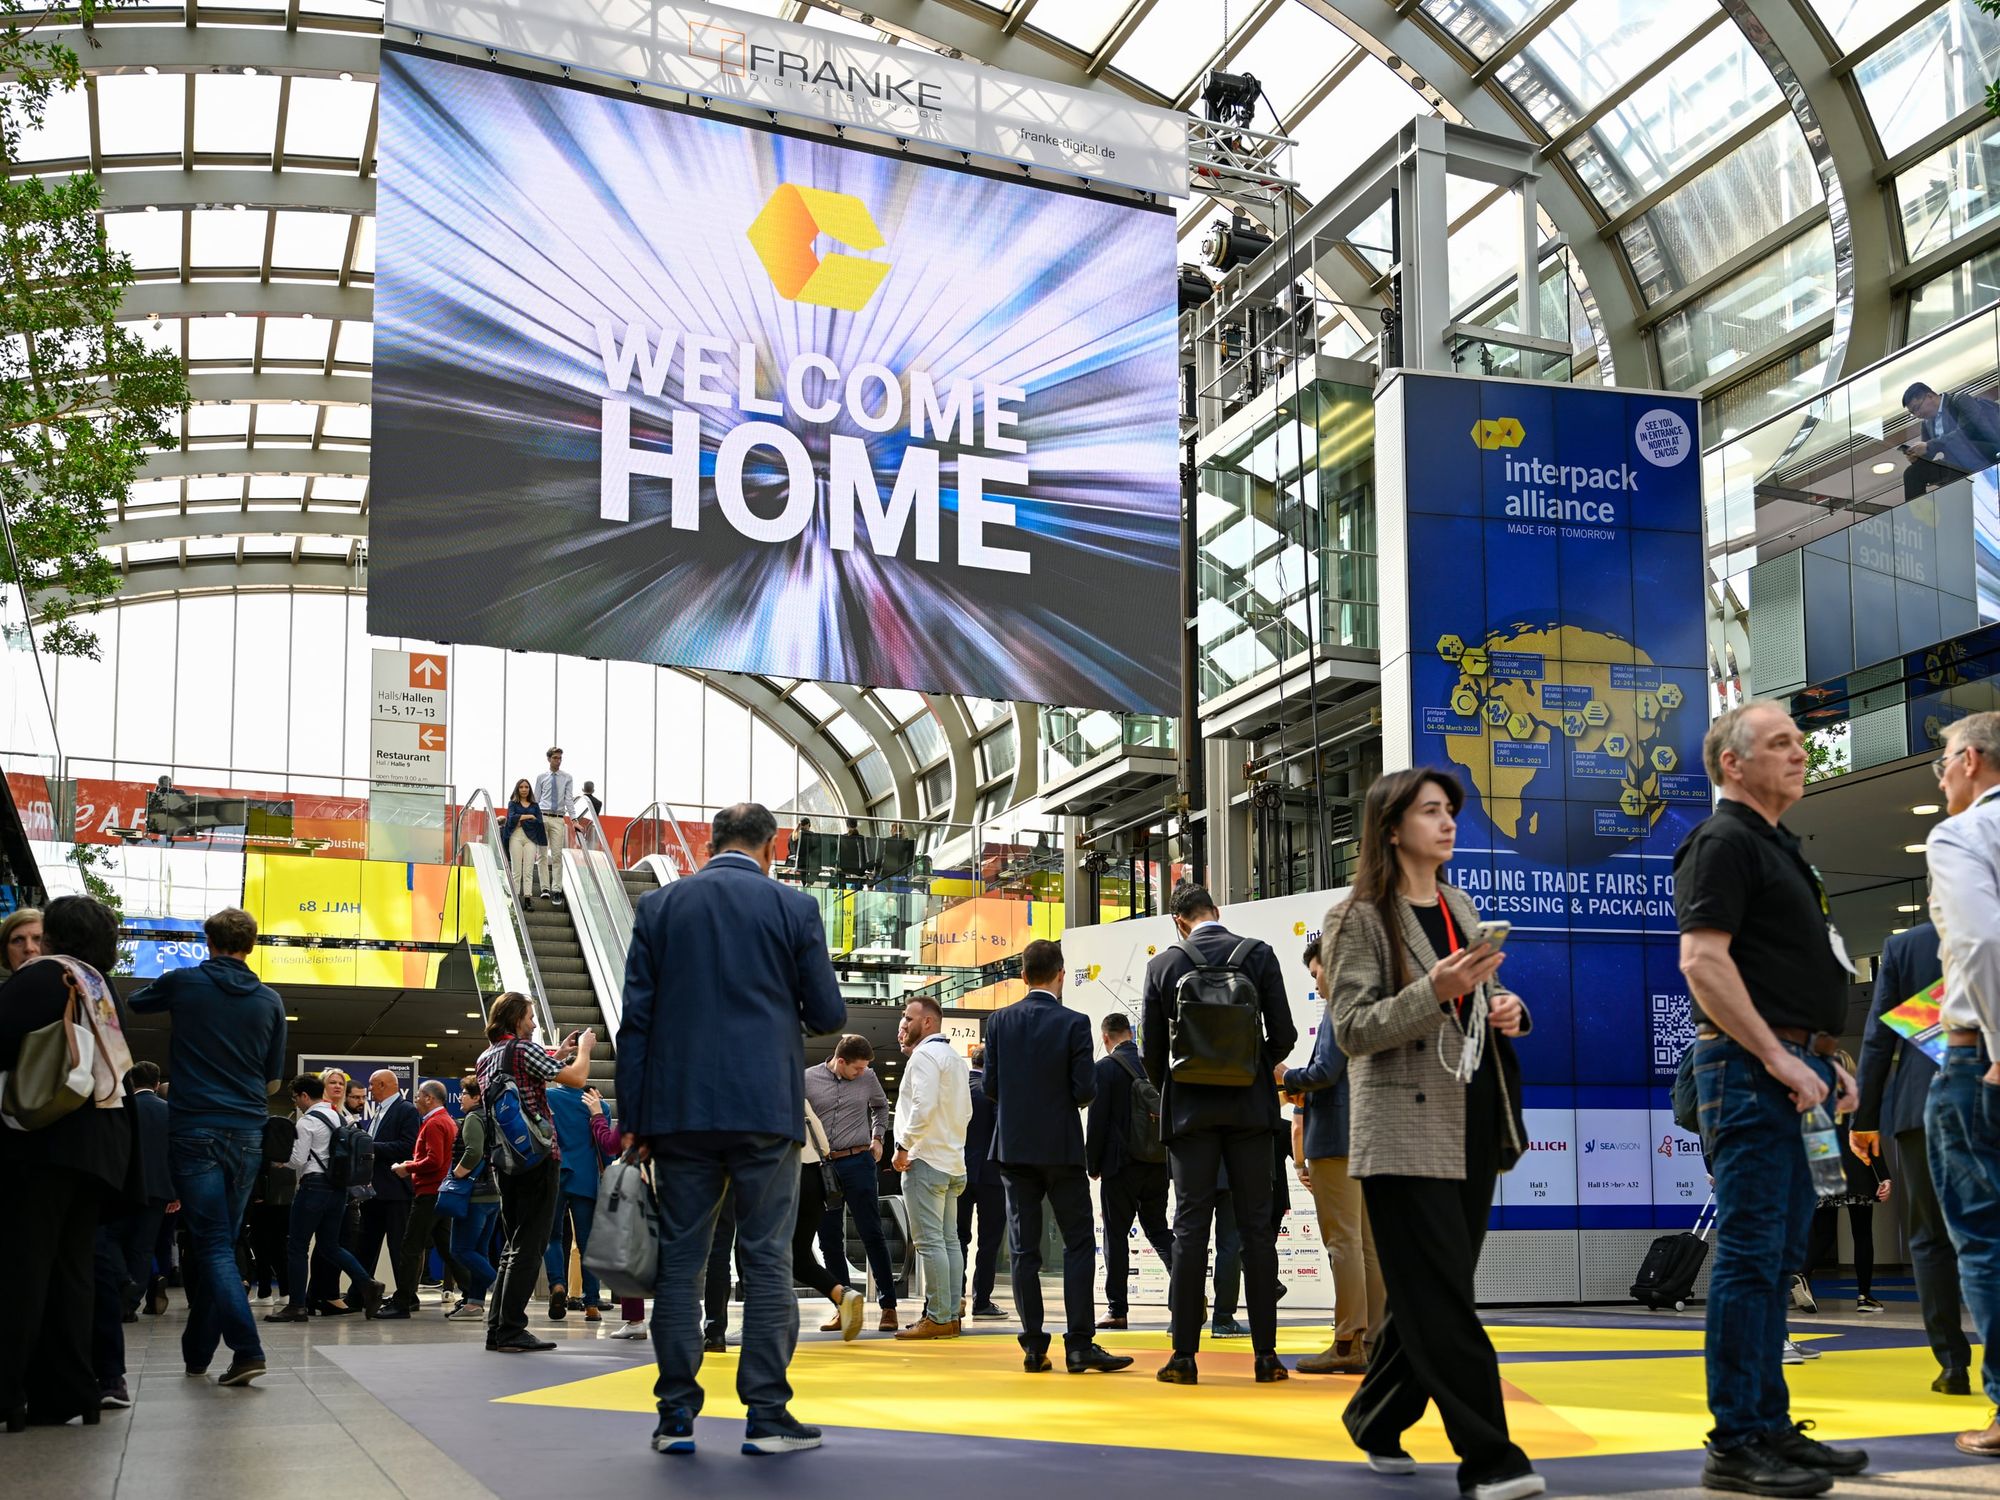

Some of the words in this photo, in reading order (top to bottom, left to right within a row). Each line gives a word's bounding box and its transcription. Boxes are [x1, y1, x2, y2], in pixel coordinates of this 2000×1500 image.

[750, 44, 943, 112] FRANKE
[749, 73, 832, 98] DIGITAL
[846, 94, 943, 121] SIGNAGE
[1020, 128, 1116, 159] franke-digital.de
[596, 318, 1028, 454] WELCOME
[1645, 420, 1658, 431] SEE
[1658, 418, 1673, 428] YOU
[1640, 432, 1648, 442] IN
[1648, 425, 1684, 440] ENTRANCE
[1648, 438, 1671, 450] NORTH
[1671, 436, 1679, 446] AT
[1505, 453, 1639, 493] interpack
[600, 398, 1031, 575] HOME
[1505, 489, 1615, 523] alliance
[1507, 523, 1535, 535] MADE
[1538, 525, 1556, 536] FOR
[1560, 527, 1615, 540] TOMORROW
[378, 691, 433, 703] Halls/Hallen
[376, 749, 430, 762] Restaurant
[1448, 868, 1525, 892] LEADING
[1531, 870, 1591, 894] TRADE
[1596, 872, 1648, 896] FAIRS
[1654, 874, 1675, 896] FO
[1473, 895, 1564, 914] OCESSING
[1570, 900, 1583, 914] &
[1588, 899, 1676, 917] PACKAGIN
[1306, 931, 1322, 943] int
[1075, 972, 1090, 980] START
[965, 1028, 976, 1037] 7.2
[1654, 1067, 1679, 1075] INTERPA
[1600, 1142, 1640, 1150] SEAVISION
[1674, 1139, 1702, 1152] Tan
